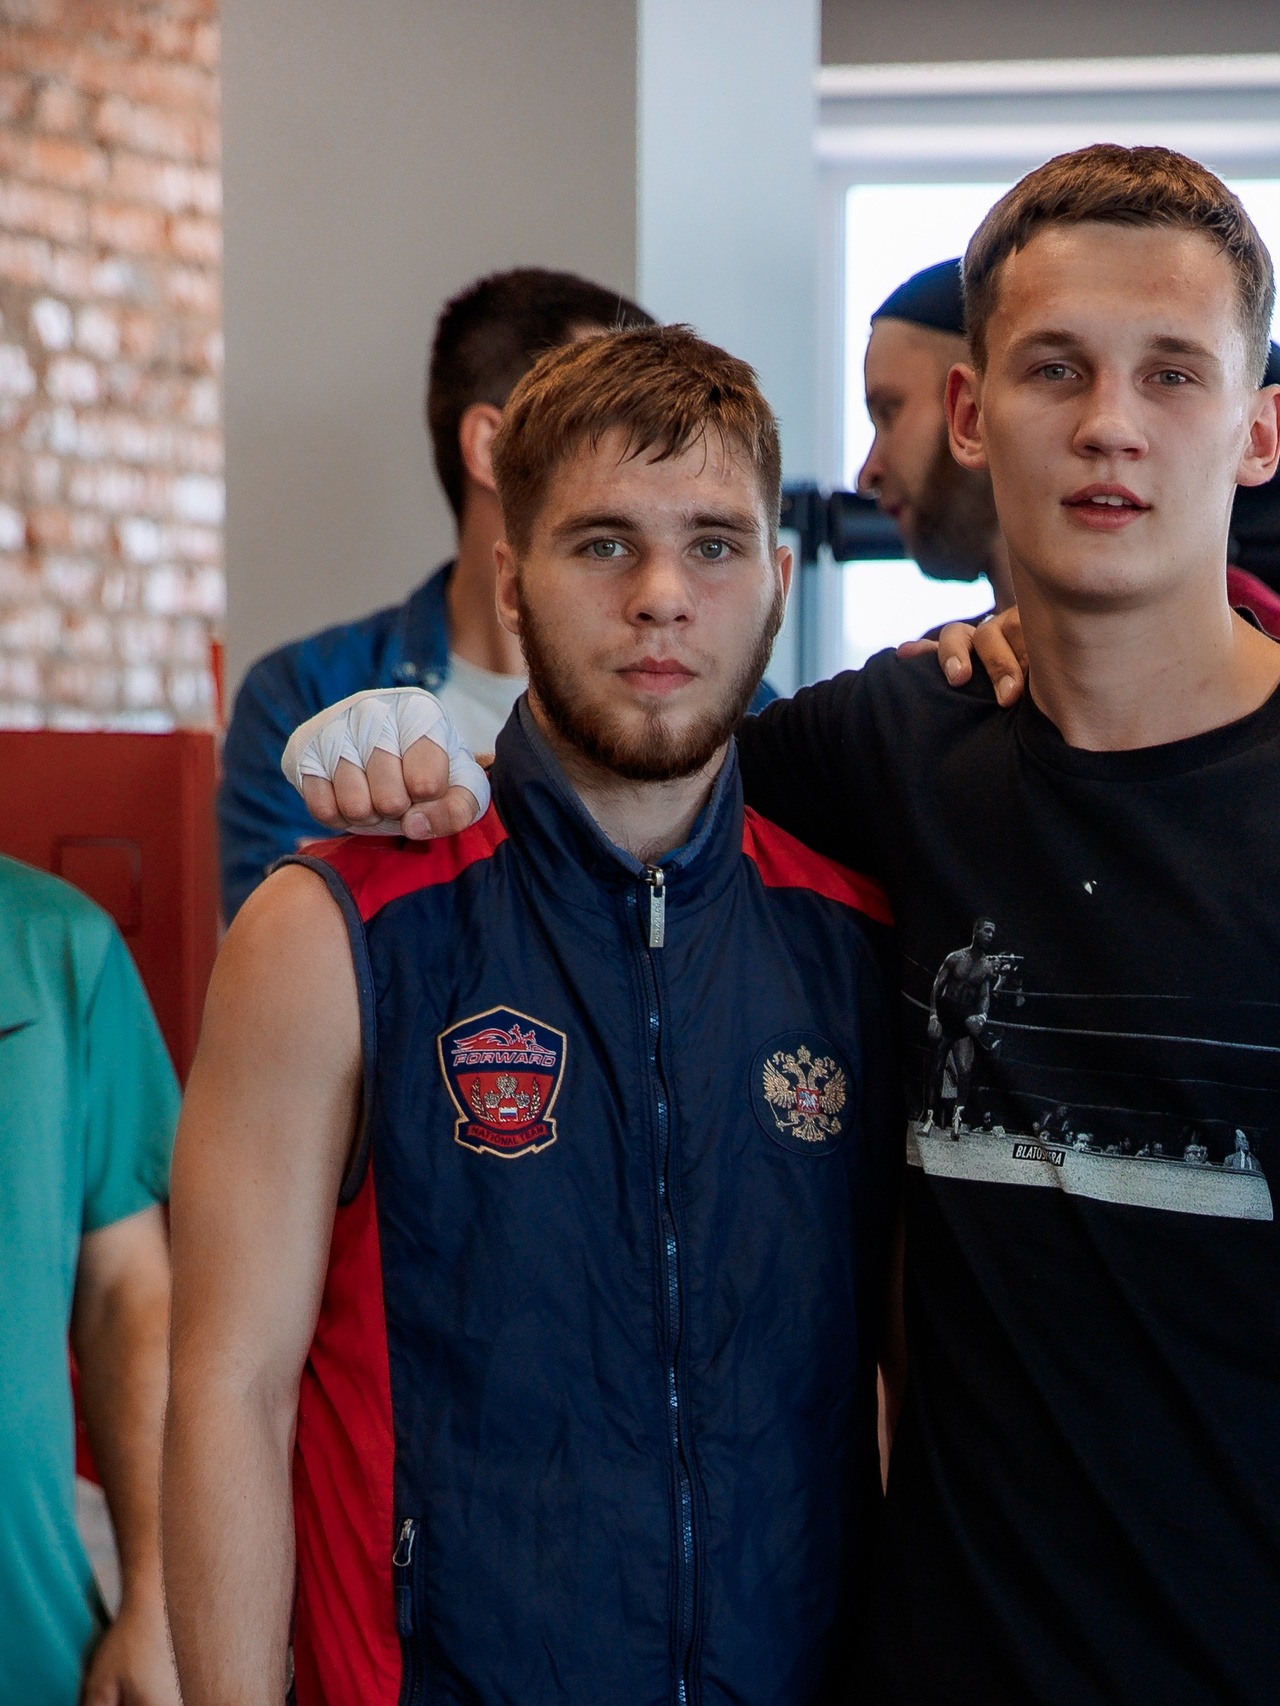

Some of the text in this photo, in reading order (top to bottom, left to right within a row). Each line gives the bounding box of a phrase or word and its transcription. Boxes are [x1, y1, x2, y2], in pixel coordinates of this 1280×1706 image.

[453, 1051, 557, 1067] FORWARD
[471, 1126, 544, 1146] NATIONAL TEAM
